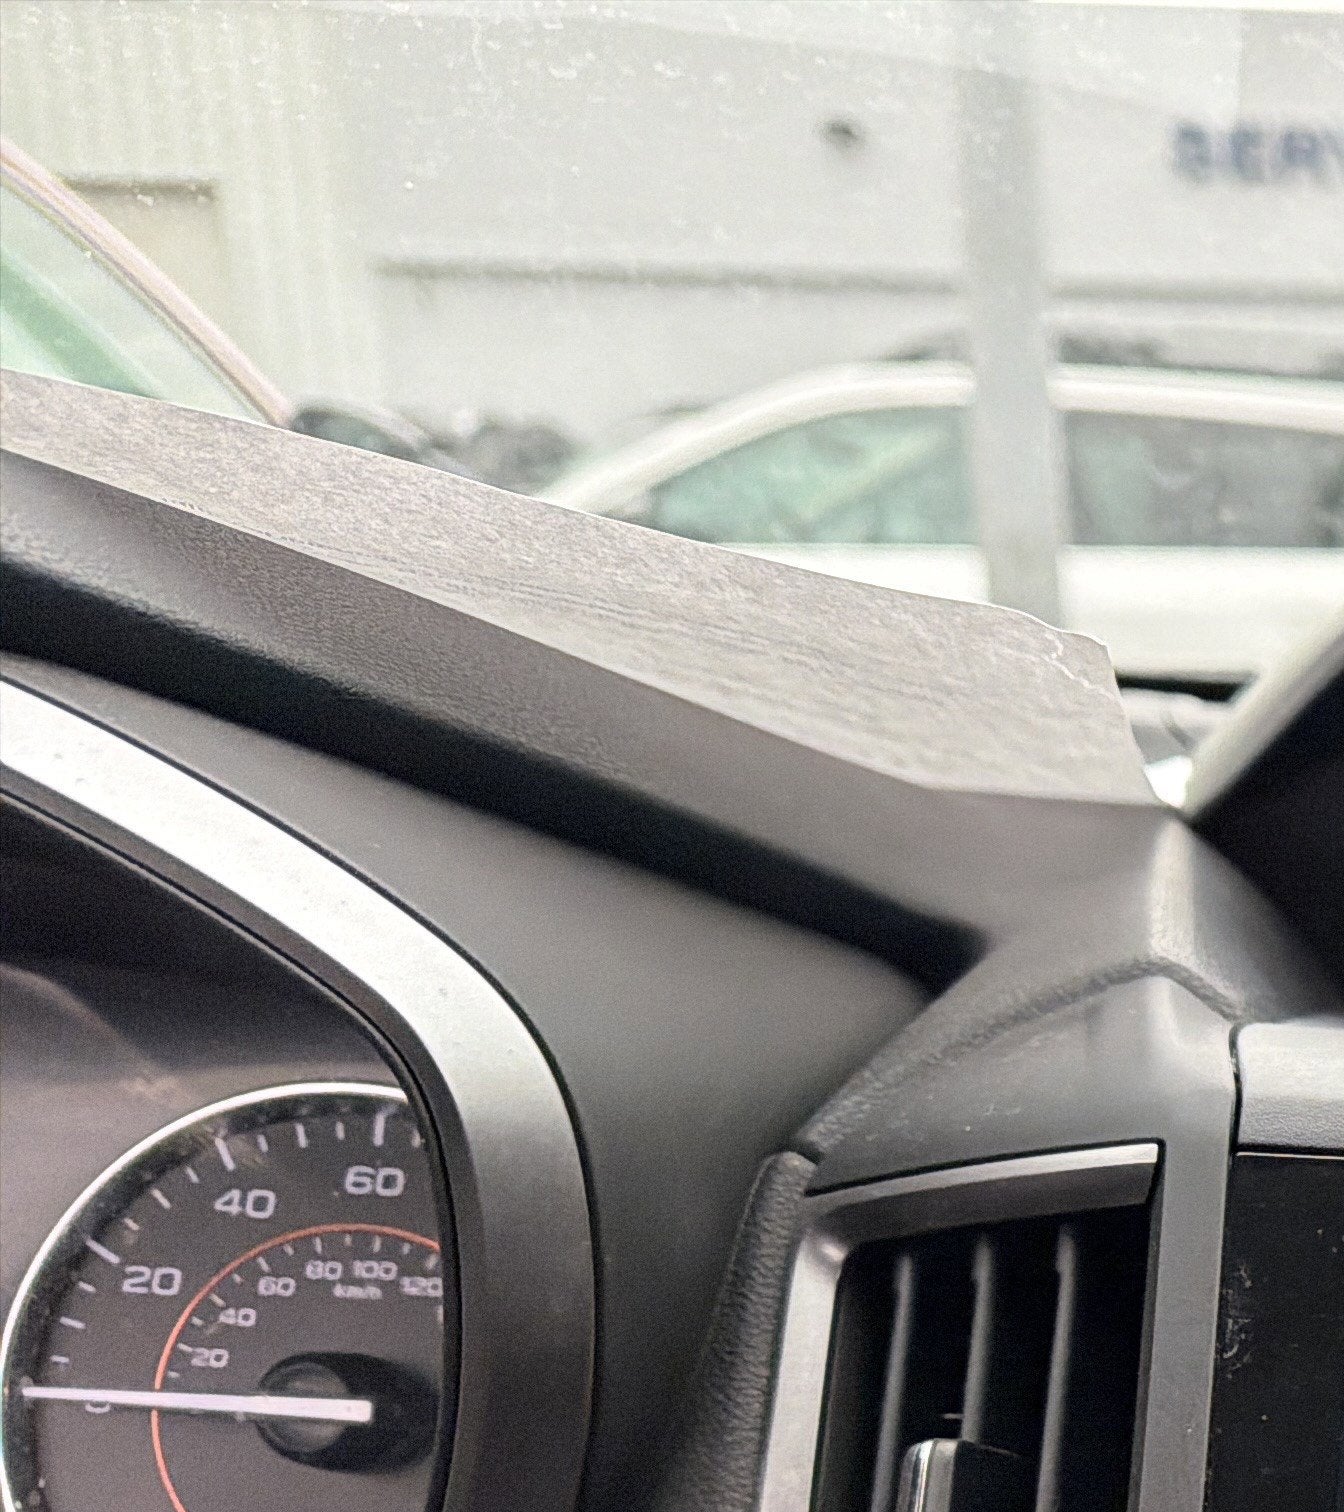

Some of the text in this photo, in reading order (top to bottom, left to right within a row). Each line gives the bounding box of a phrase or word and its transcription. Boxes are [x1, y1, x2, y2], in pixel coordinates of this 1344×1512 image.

[343, 1164, 406, 1198] 60
[213, 1187, 277, 1220] 40
[120, 1264, 183, 1297] 20
[305, 1260, 343, 1280] 80
[353, 1260, 399, 1280] 100
[257, 1275, 297, 1297] 60
[219, 1307, 257, 1328] 40
[190, 1347, 229, 1368] 20
